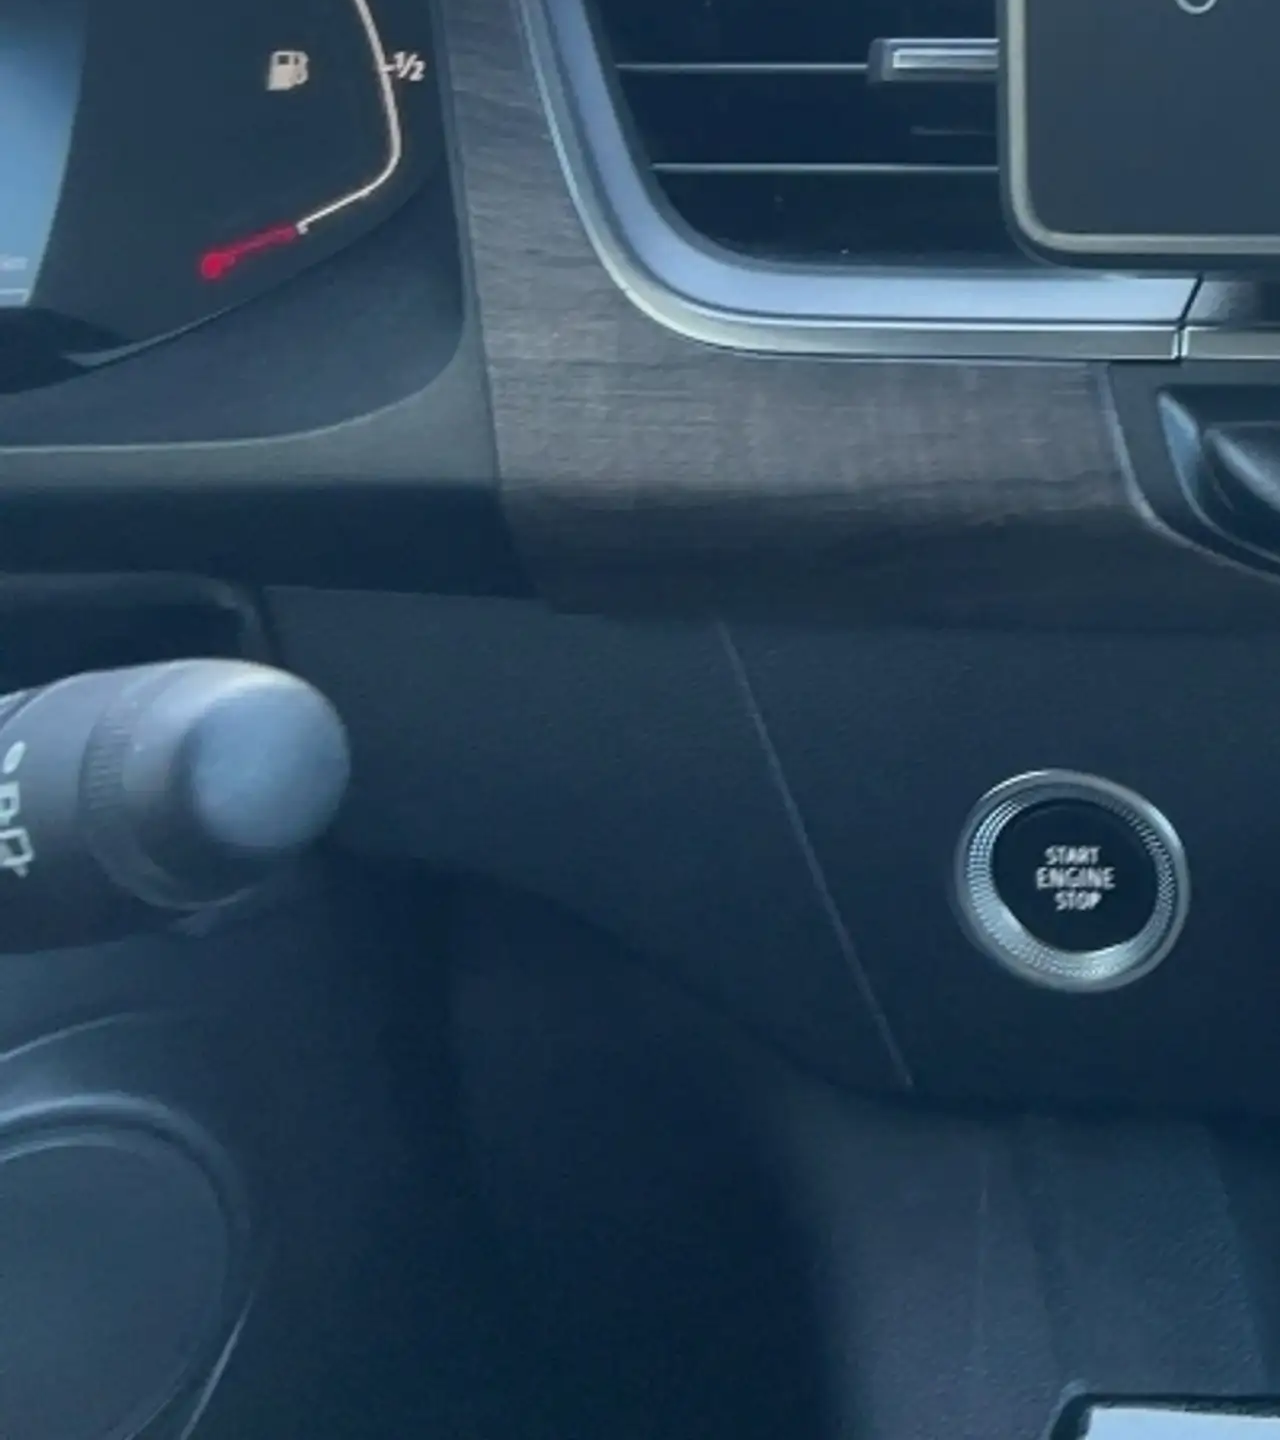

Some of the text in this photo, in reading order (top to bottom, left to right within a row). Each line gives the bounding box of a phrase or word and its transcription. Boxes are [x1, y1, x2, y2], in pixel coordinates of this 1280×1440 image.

[1044, 845, 1101, 865] START
[1036, 867, 1116, 890] ENGINE
[1054, 890, 1102, 911] STOP
